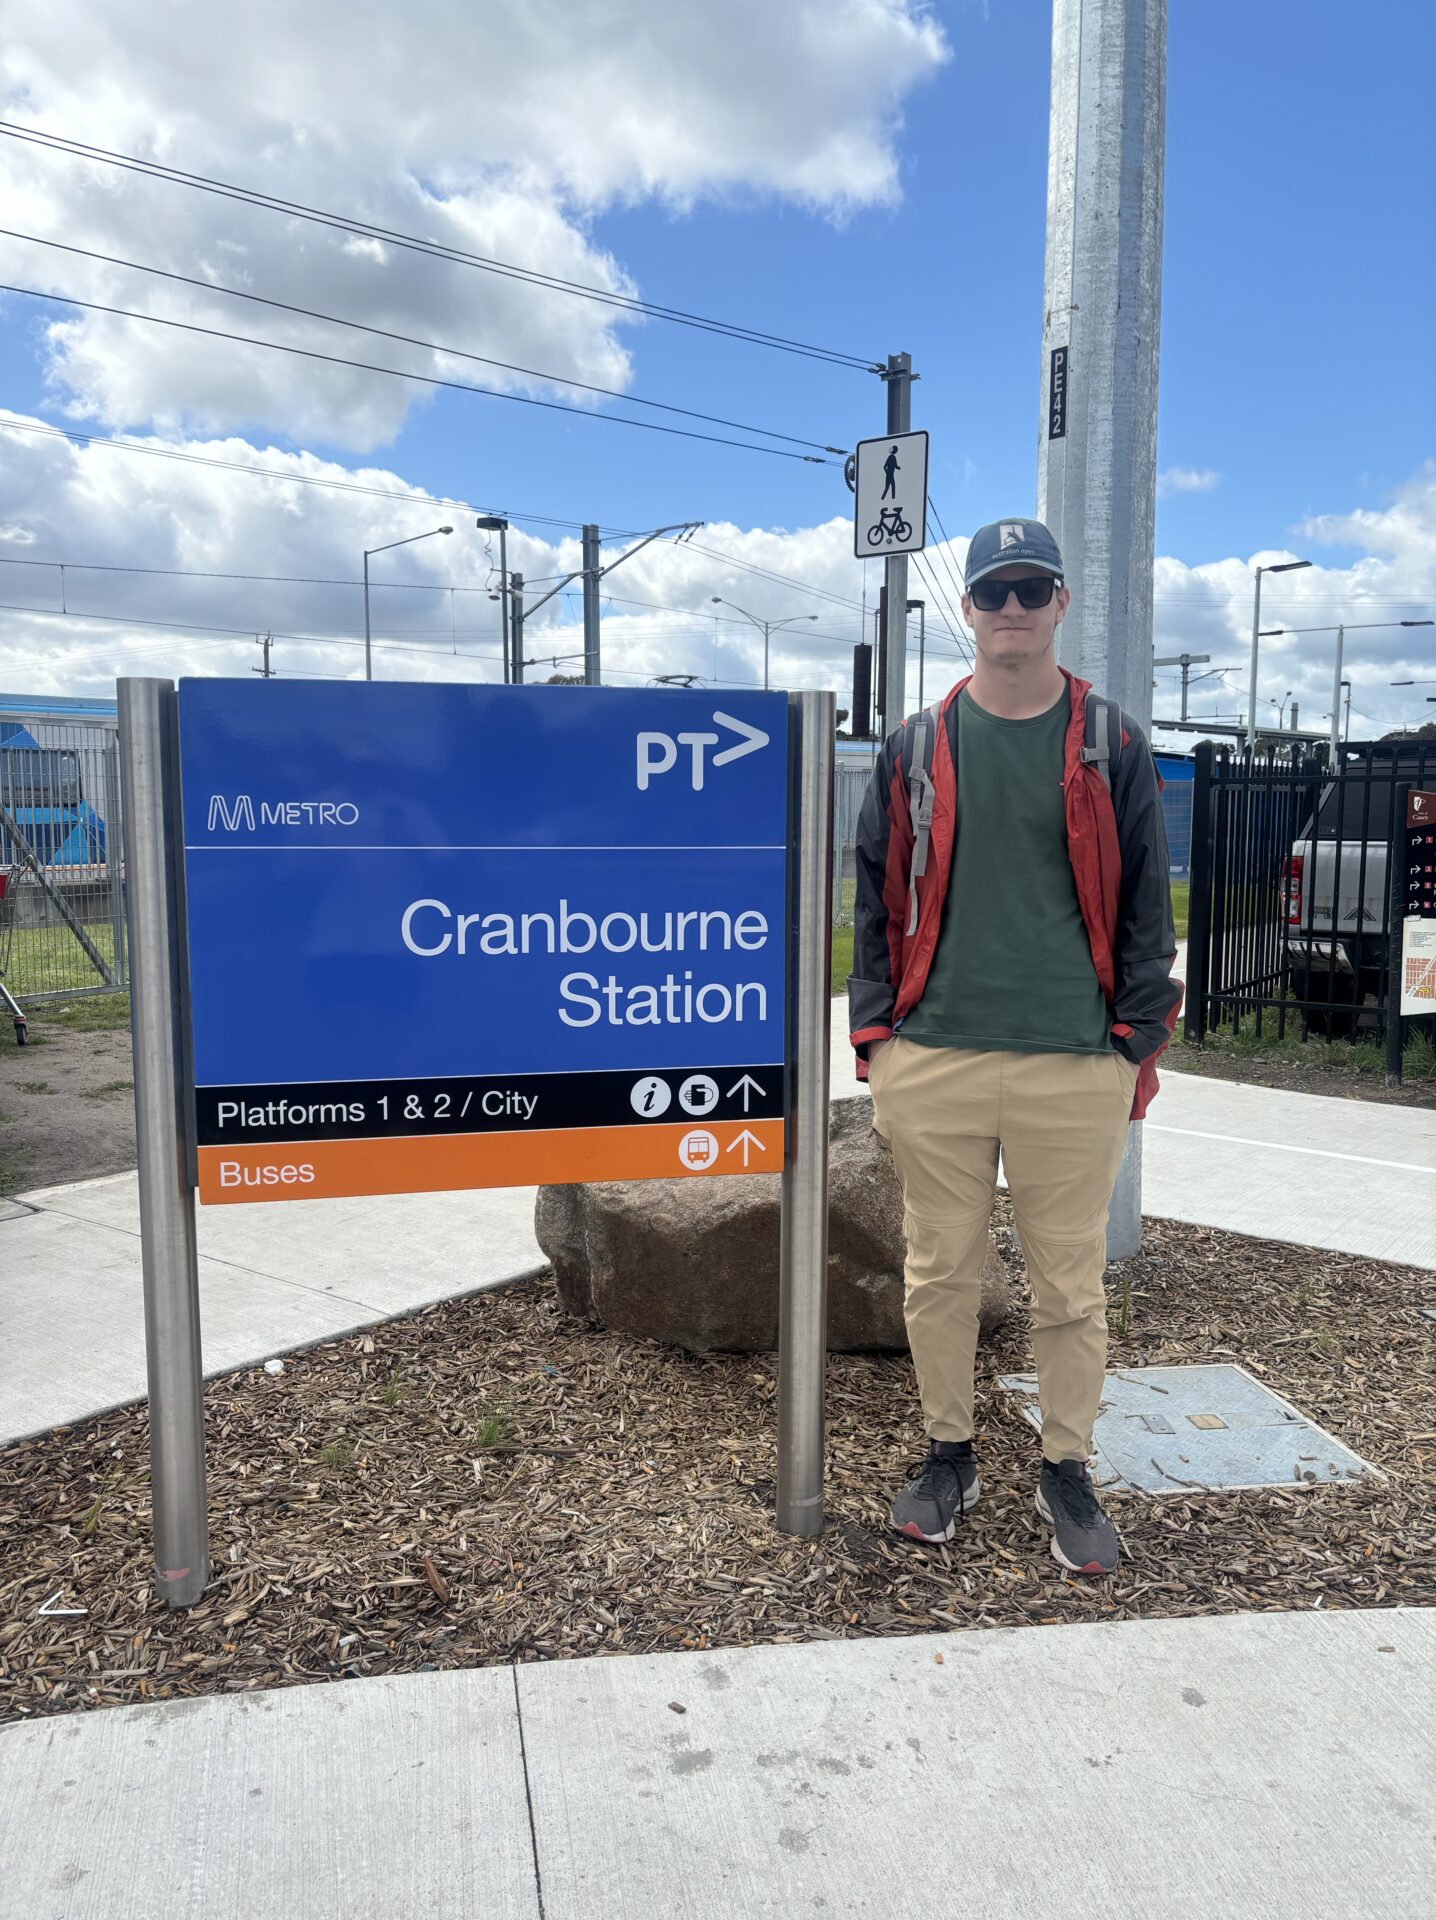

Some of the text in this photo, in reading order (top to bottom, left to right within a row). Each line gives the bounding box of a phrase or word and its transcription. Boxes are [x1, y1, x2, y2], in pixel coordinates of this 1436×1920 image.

[1053, 352, 1064, 434] PE42
[261, 802, 360, 826] METRO
[401, 898, 769, 957] Cranbourne
[558, 970, 767, 1028] Station
[216, 1089, 539, 1128] Platforms 1 & 2 / City
[219, 1161, 316, 1187] Buses
